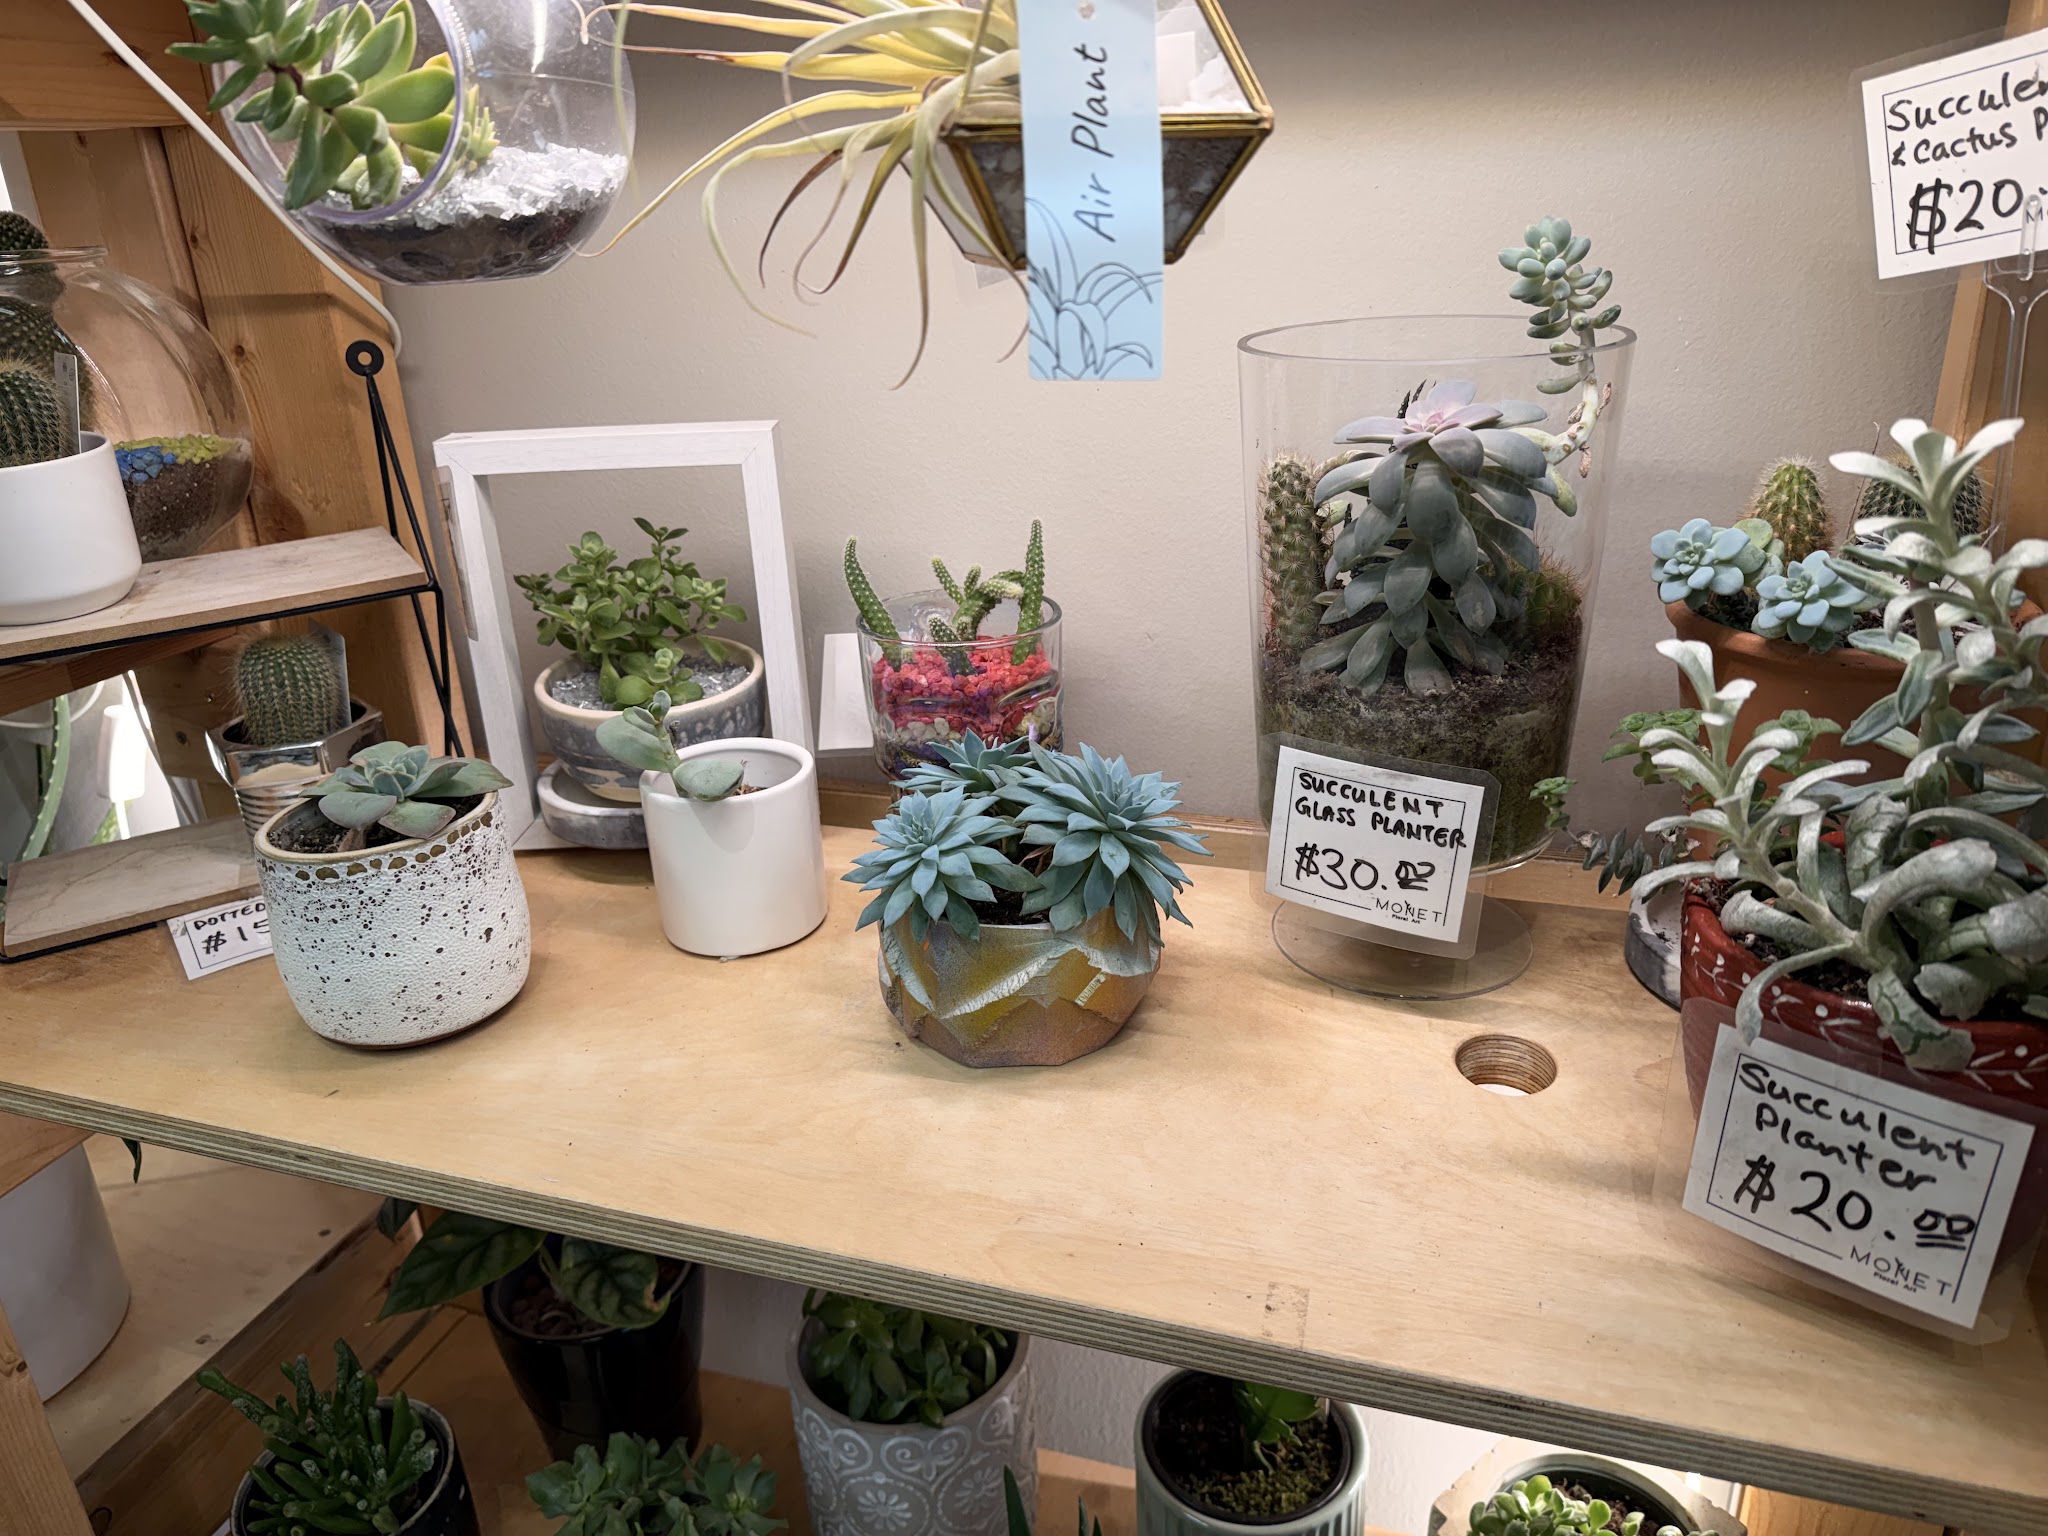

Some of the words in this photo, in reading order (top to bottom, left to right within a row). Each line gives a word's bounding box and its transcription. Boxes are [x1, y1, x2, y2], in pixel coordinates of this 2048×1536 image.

[1071, 44, 1115, 157] Plant
[1073, 173, 1116, 242] Air
[1299, 772, 1443, 818] SUCCULENT
[1295, 797, 1356, 826] GLASS
[1371, 812, 1467, 849] PLANTER
[193, 902, 266, 930] DOTTED
[1376, 898, 1442, 922] MONET
[1739, 1063, 1975, 1170] Succulent
[1755, 1103, 1937, 1191] Planter
[1850, 1245, 1952, 1295] MONET
